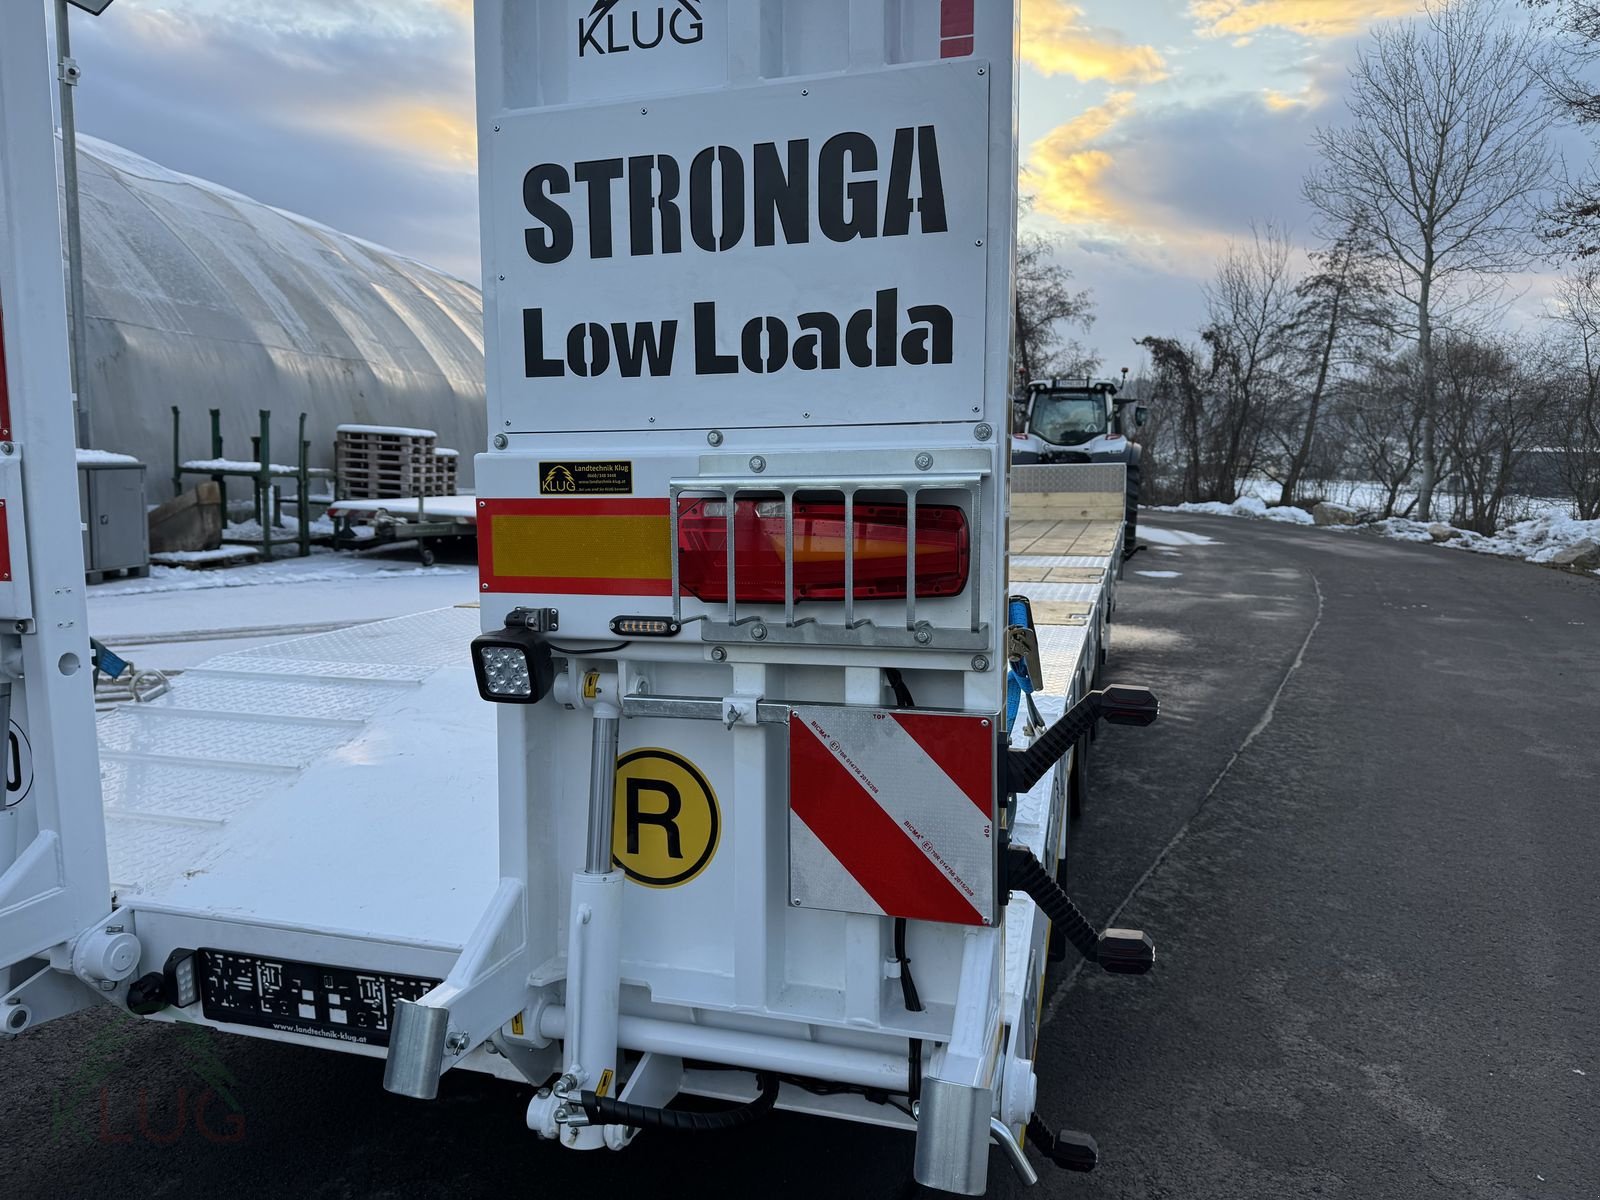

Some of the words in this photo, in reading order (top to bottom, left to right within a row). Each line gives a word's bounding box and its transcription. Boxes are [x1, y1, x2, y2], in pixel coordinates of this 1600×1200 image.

[579, 7, 703, 57] KLUG
[523, 125, 948, 264] STRONGA
[523, 307, 678, 378] Low
[694, 287, 953, 375] Loada
[542, 480, 576, 492] KLUG
[574, 464, 613, 472] Landtechnik
[614, 464, 629, 473] Klug
[626, 777, 683, 859] R
[272, 1022, 367, 1044] www.landtechnik-klug.at
